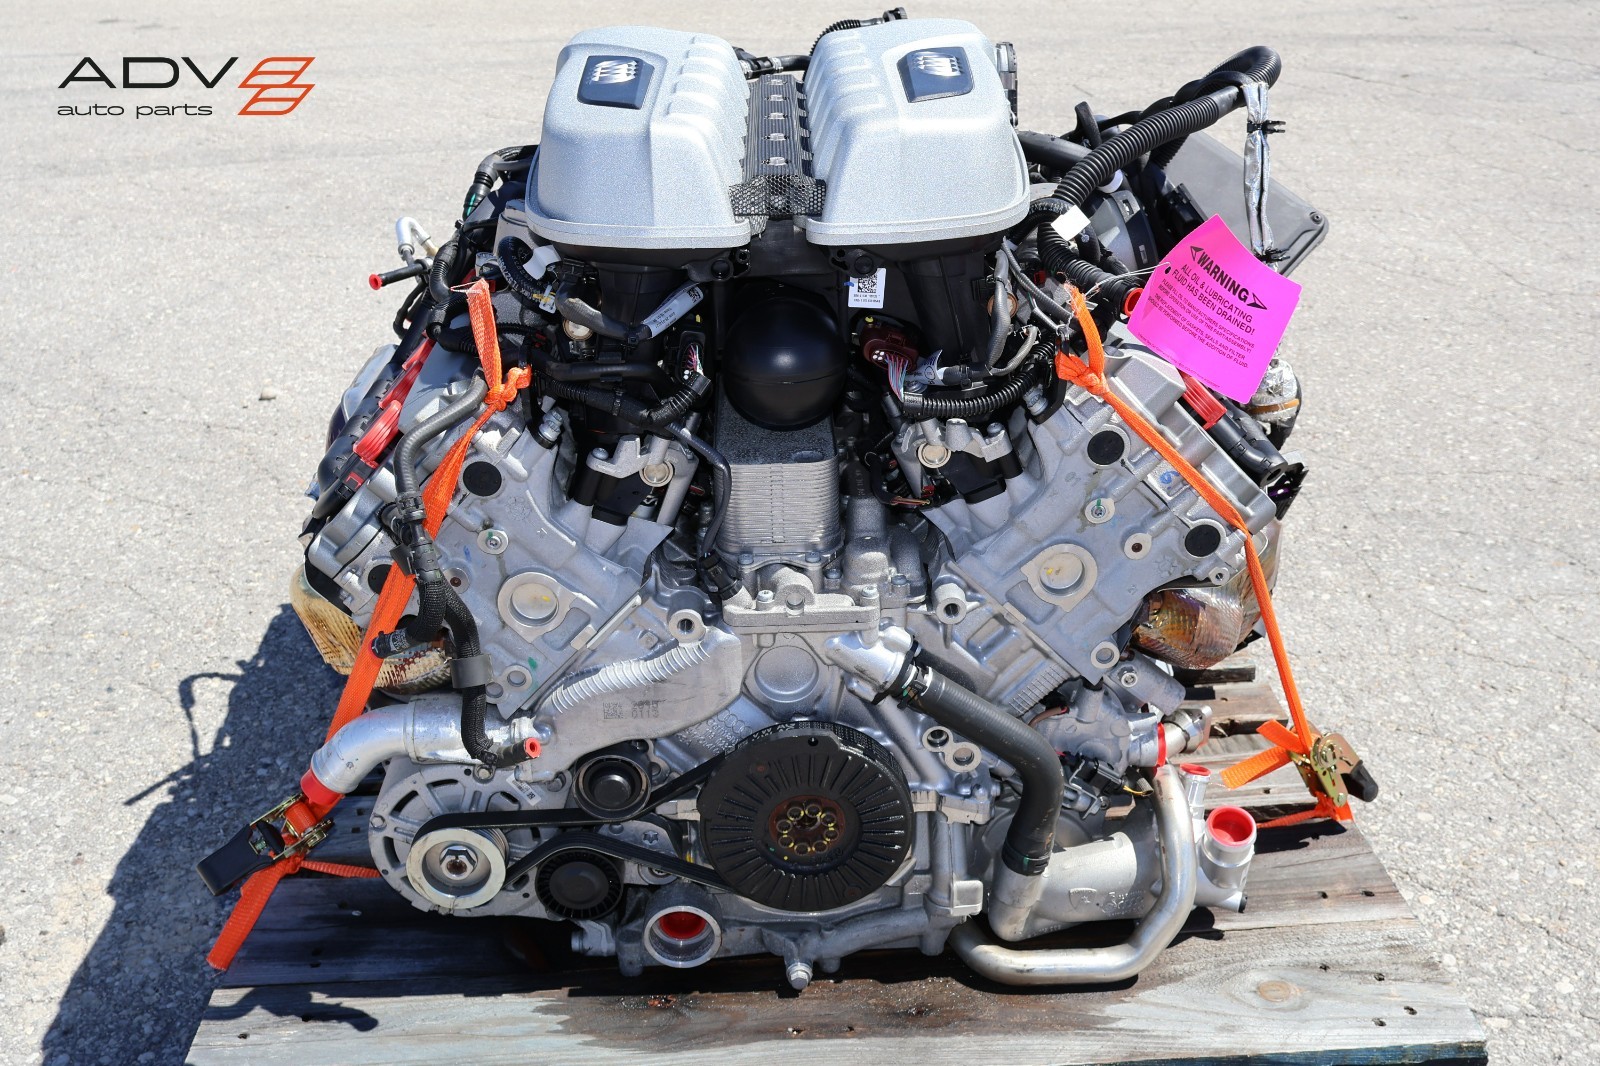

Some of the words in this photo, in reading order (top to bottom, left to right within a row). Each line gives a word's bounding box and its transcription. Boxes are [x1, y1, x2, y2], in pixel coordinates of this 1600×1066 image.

[1181, 263, 1192, 277] ALL
[1190, 272, 1201, 285] OIL
[1199, 281, 1206, 289] &
[1204, 285, 1253, 323] LUBRICATING
[1197, 251, 1250, 303] WARNING
[1172, 269, 1188, 286] FLUID
[1186, 282, 1199, 297] HAS
[1197, 292, 1217, 311] BEEN
[1216, 307, 1256, 336] DRAINED!
[1197, 335, 1206, 344] THE
[1205, 341, 1227, 357] ADDITION
[1205, 333, 1219, 345] SEALS
[1218, 342, 1229, 351] AND
[1228, 348, 1246, 361] FILTER
[1218, 324, 1255, 349] SPECIFICATIONS
